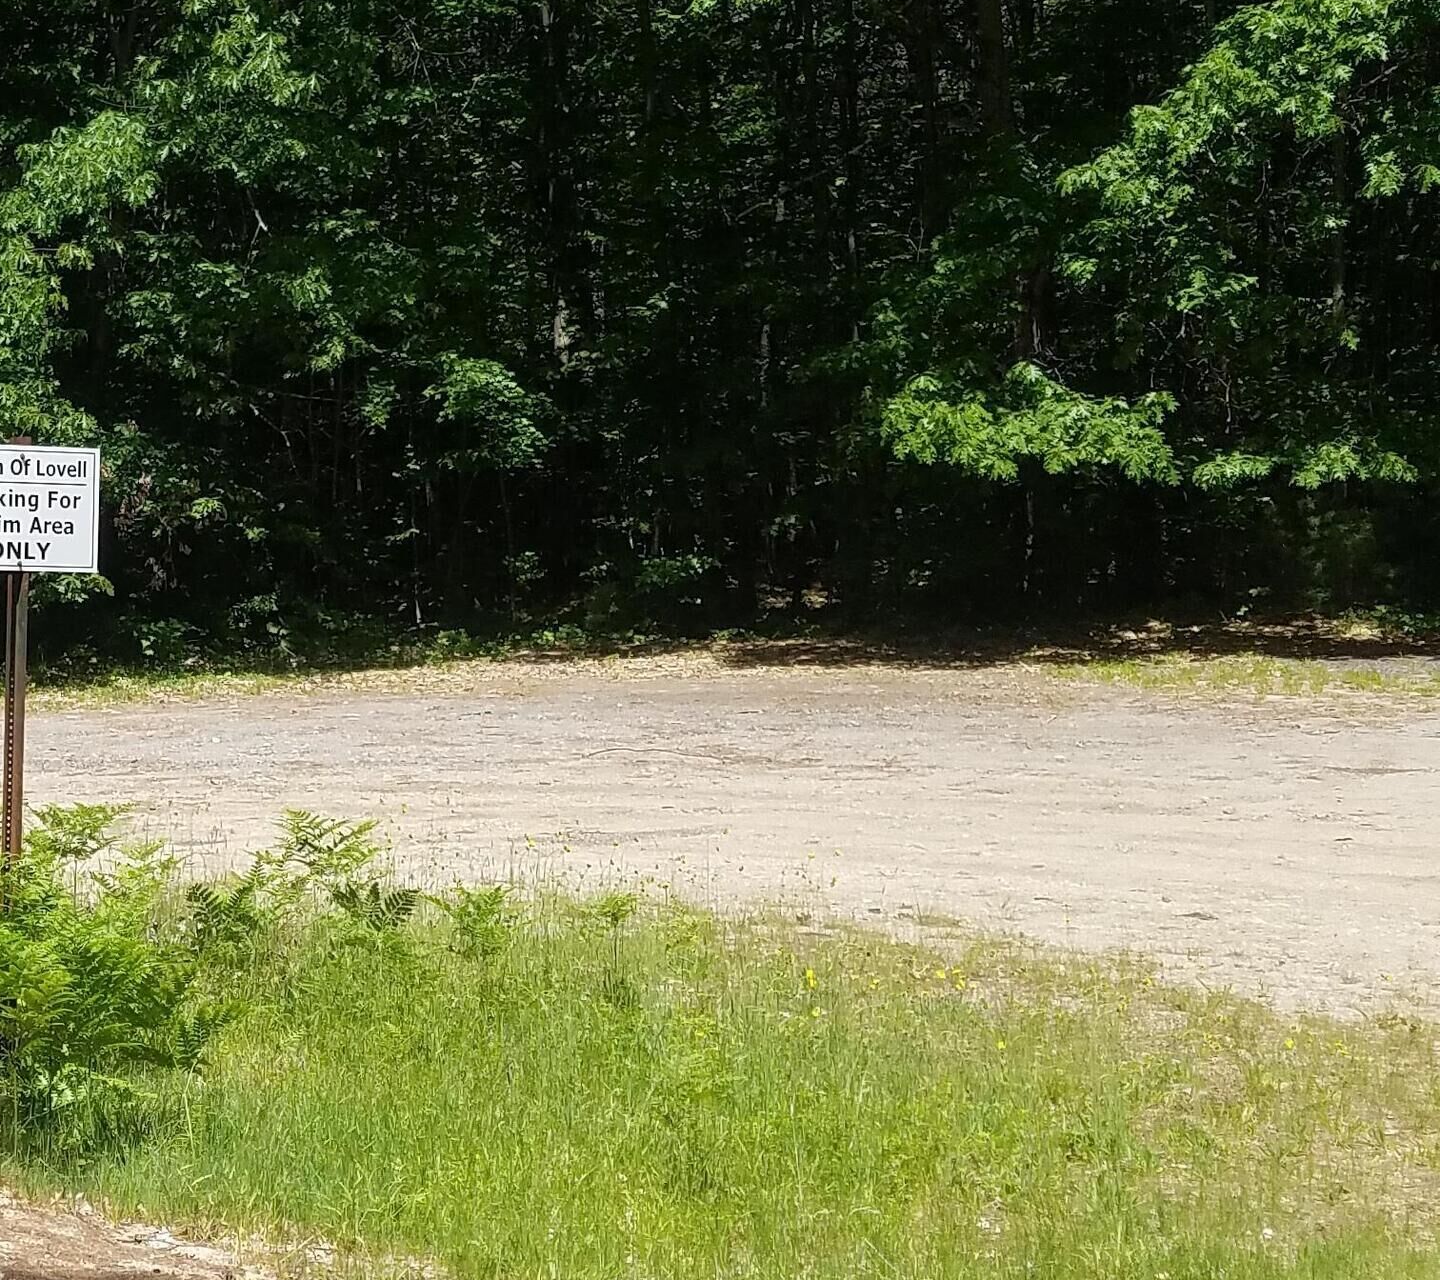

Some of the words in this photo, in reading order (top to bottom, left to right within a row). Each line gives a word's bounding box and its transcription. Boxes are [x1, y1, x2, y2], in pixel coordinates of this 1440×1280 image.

[11, 458, 31, 475] Of
[37, 460, 87, 478] Lovell
[48, 491, 81, 509] For
[30, 517, 74, 534] Area
